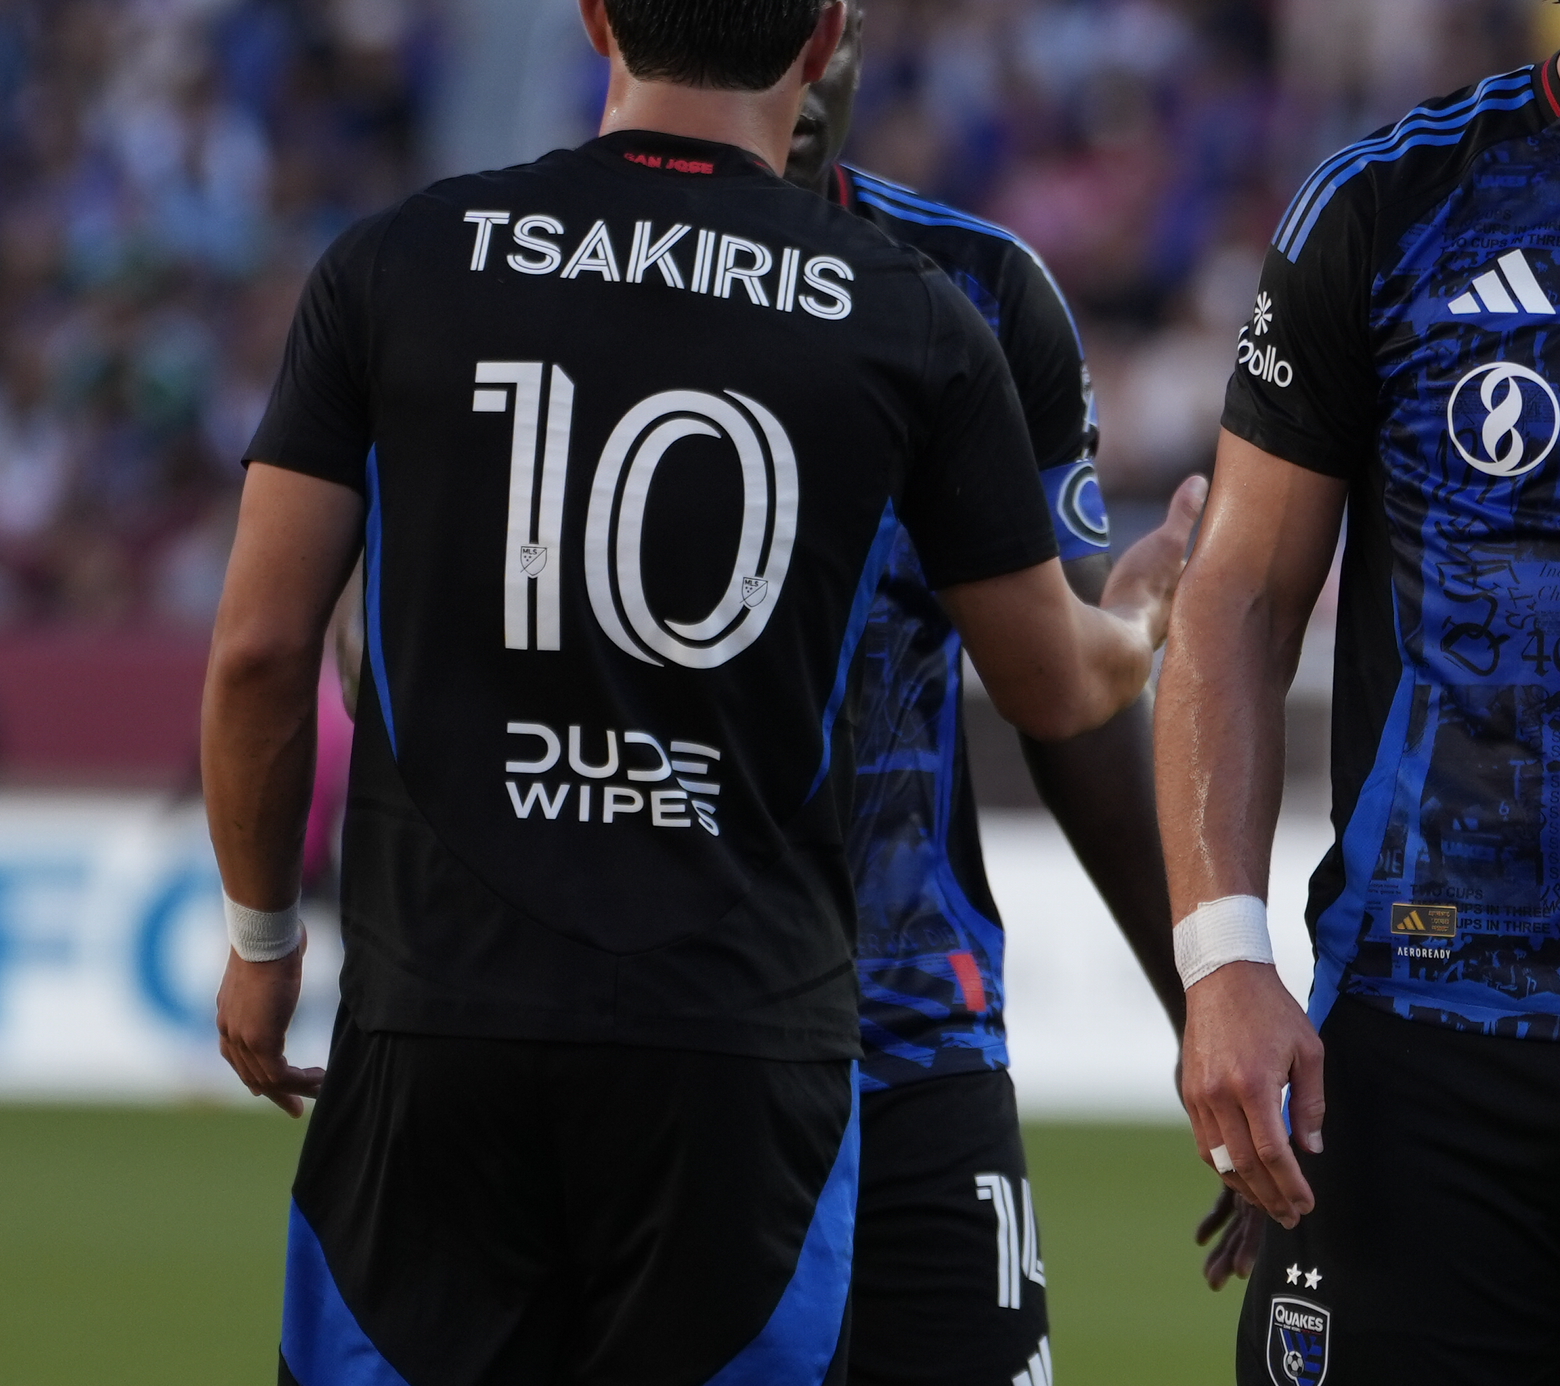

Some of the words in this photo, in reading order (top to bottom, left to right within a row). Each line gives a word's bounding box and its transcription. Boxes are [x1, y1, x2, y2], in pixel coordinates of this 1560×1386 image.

[623, 152, 663, 169] SAN
[1471, 236, 1508, 249] CUPS
[462, 209, 855, 321] TSAKIRIS
[1056, 462, 1111, 548] C
[471, 361, 799, 669] 10
[522, 548, 538, 556] MLS
[744, 579, 759, 587] MLS
[505, 721, 721, 795] DUDE
[504, 781, 720, 837] WIPES
[1446, 886, 1484, 900] CUPS
[1486, 903, 1499, 916] IN
[1486, 918, 1500, 931] IN
[1503, 920, 1551, 934] THREE
[1397, 946, 1451, 960] AEROREADY
[1274, 1304, 1324, 1333] QUAKES
